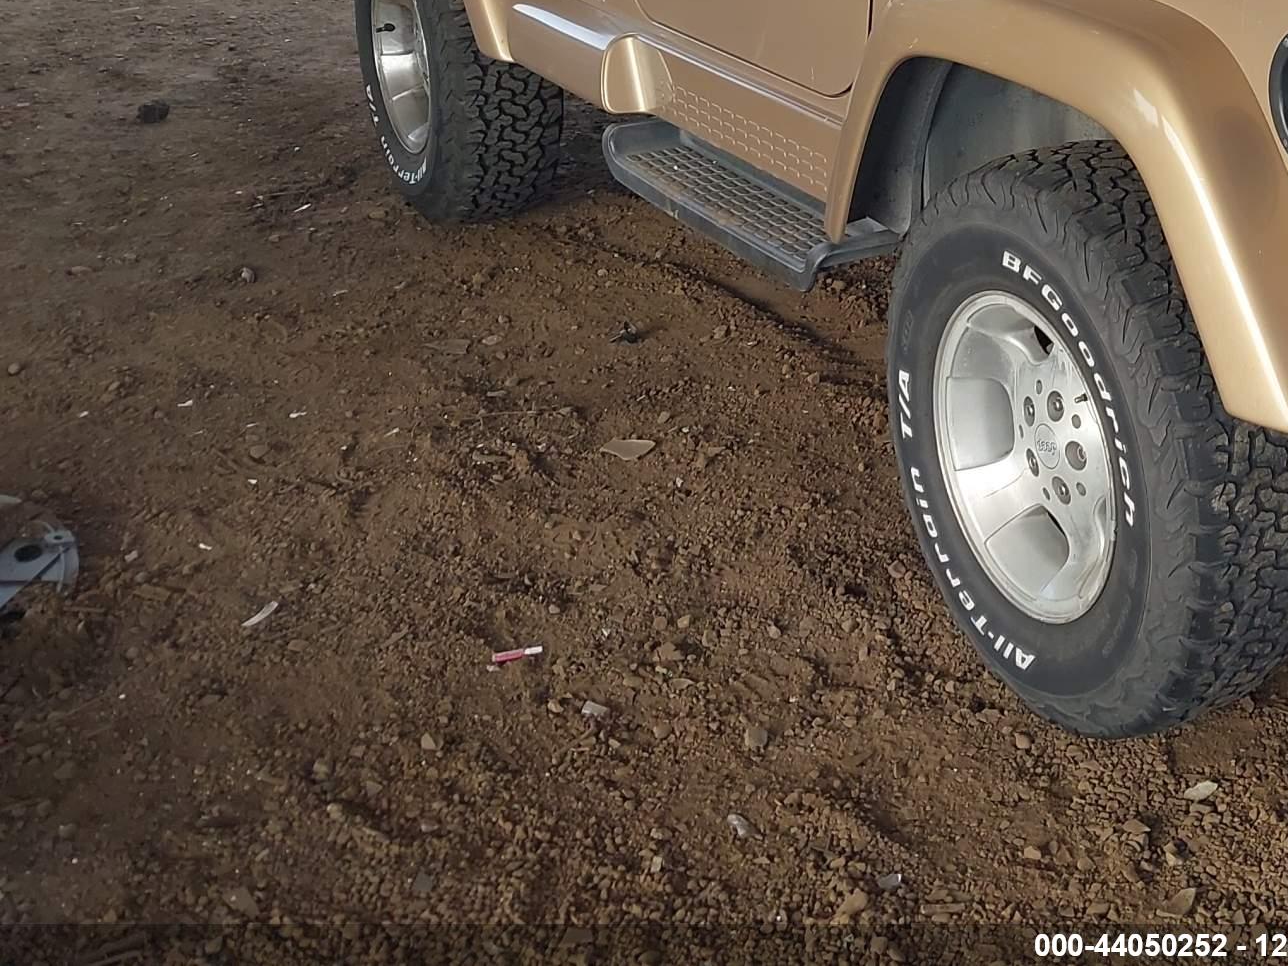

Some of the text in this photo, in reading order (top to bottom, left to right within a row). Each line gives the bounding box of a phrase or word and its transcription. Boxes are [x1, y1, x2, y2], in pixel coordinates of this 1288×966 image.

[896, 368, 913, 440] T/A
[1000, 249, 1138, 529] BFGoodrich
[910, 464, 1038, 672] All-Terrain
